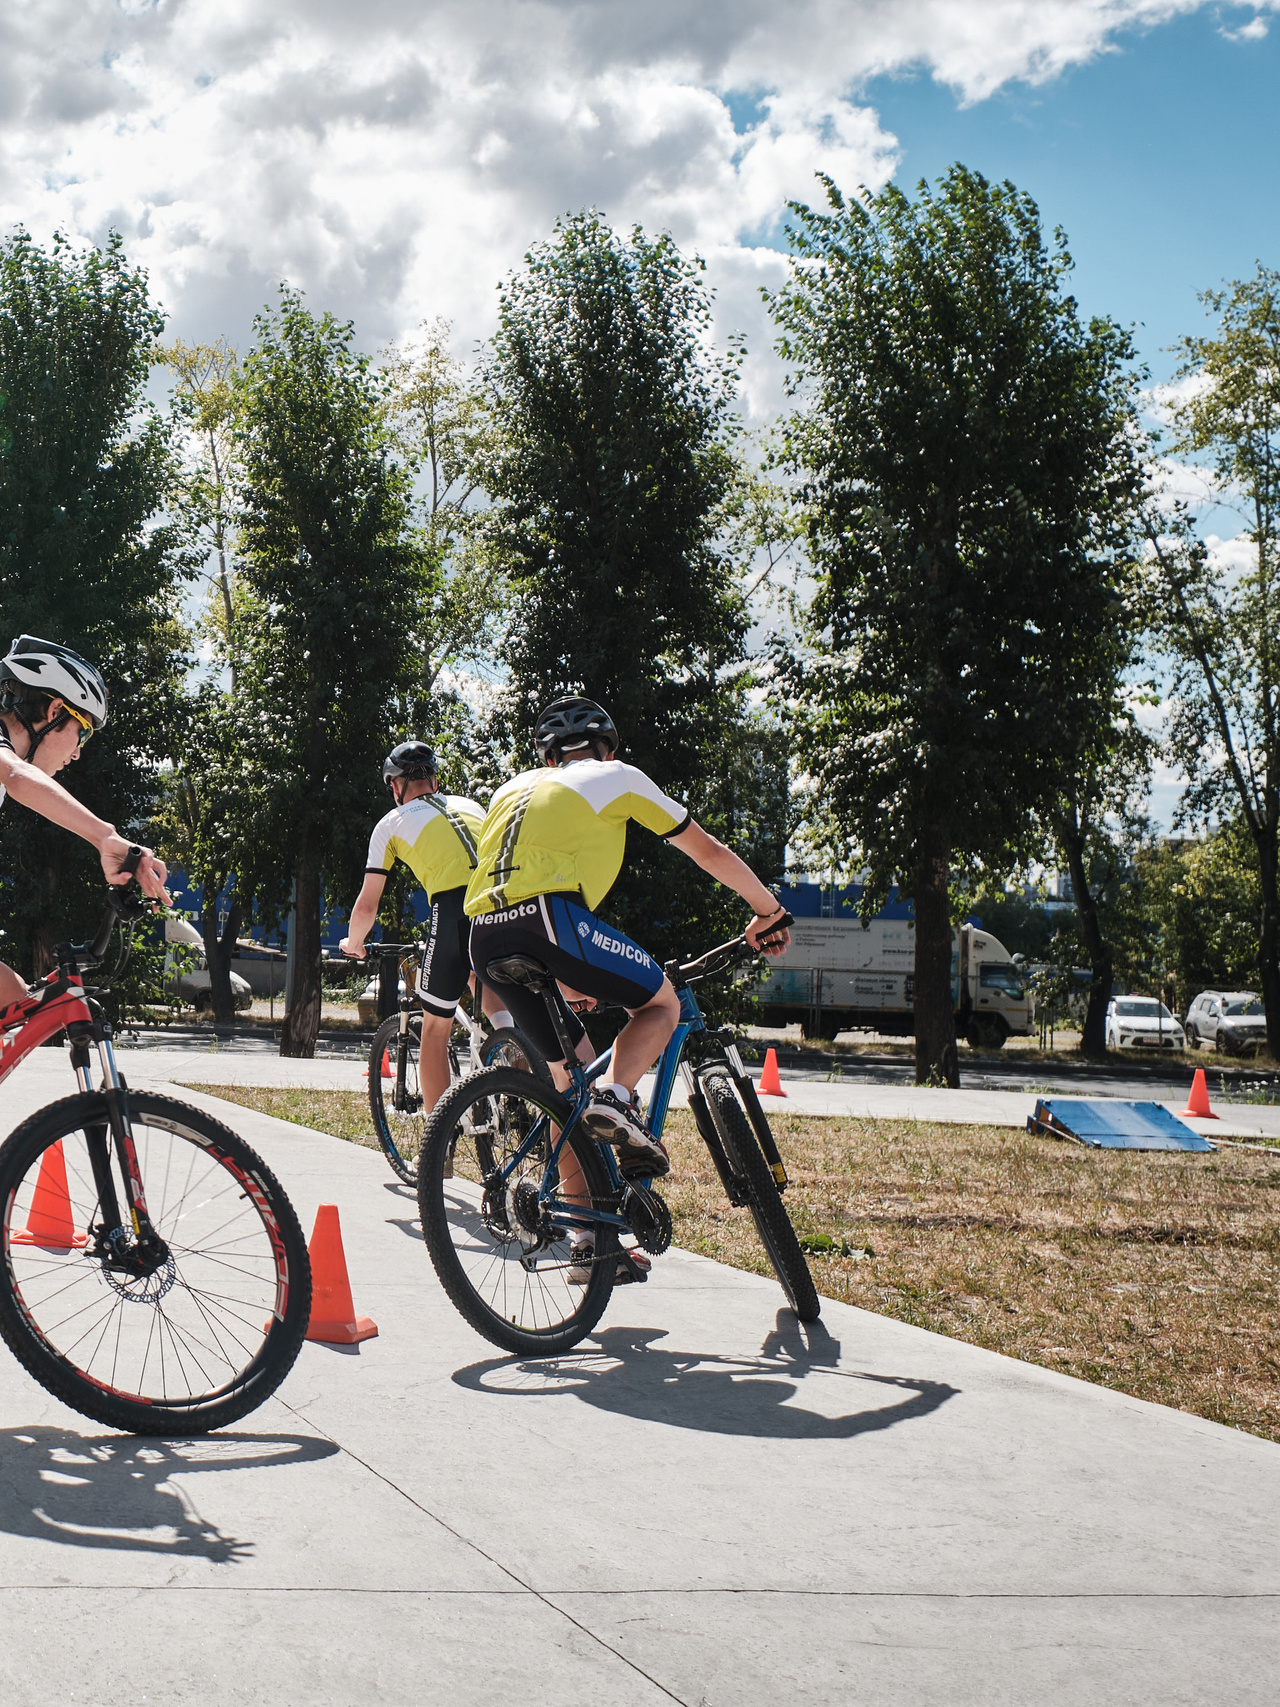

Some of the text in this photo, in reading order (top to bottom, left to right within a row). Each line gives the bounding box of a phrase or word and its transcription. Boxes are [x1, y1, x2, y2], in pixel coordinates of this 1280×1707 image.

[474, 903, 537, 926] Nemoto
[421, 902, 440, 990] СВЕРДЛОВСКАЯ ОБЛАСТЬ
[591, 929, 652, 970] MEDICOR
